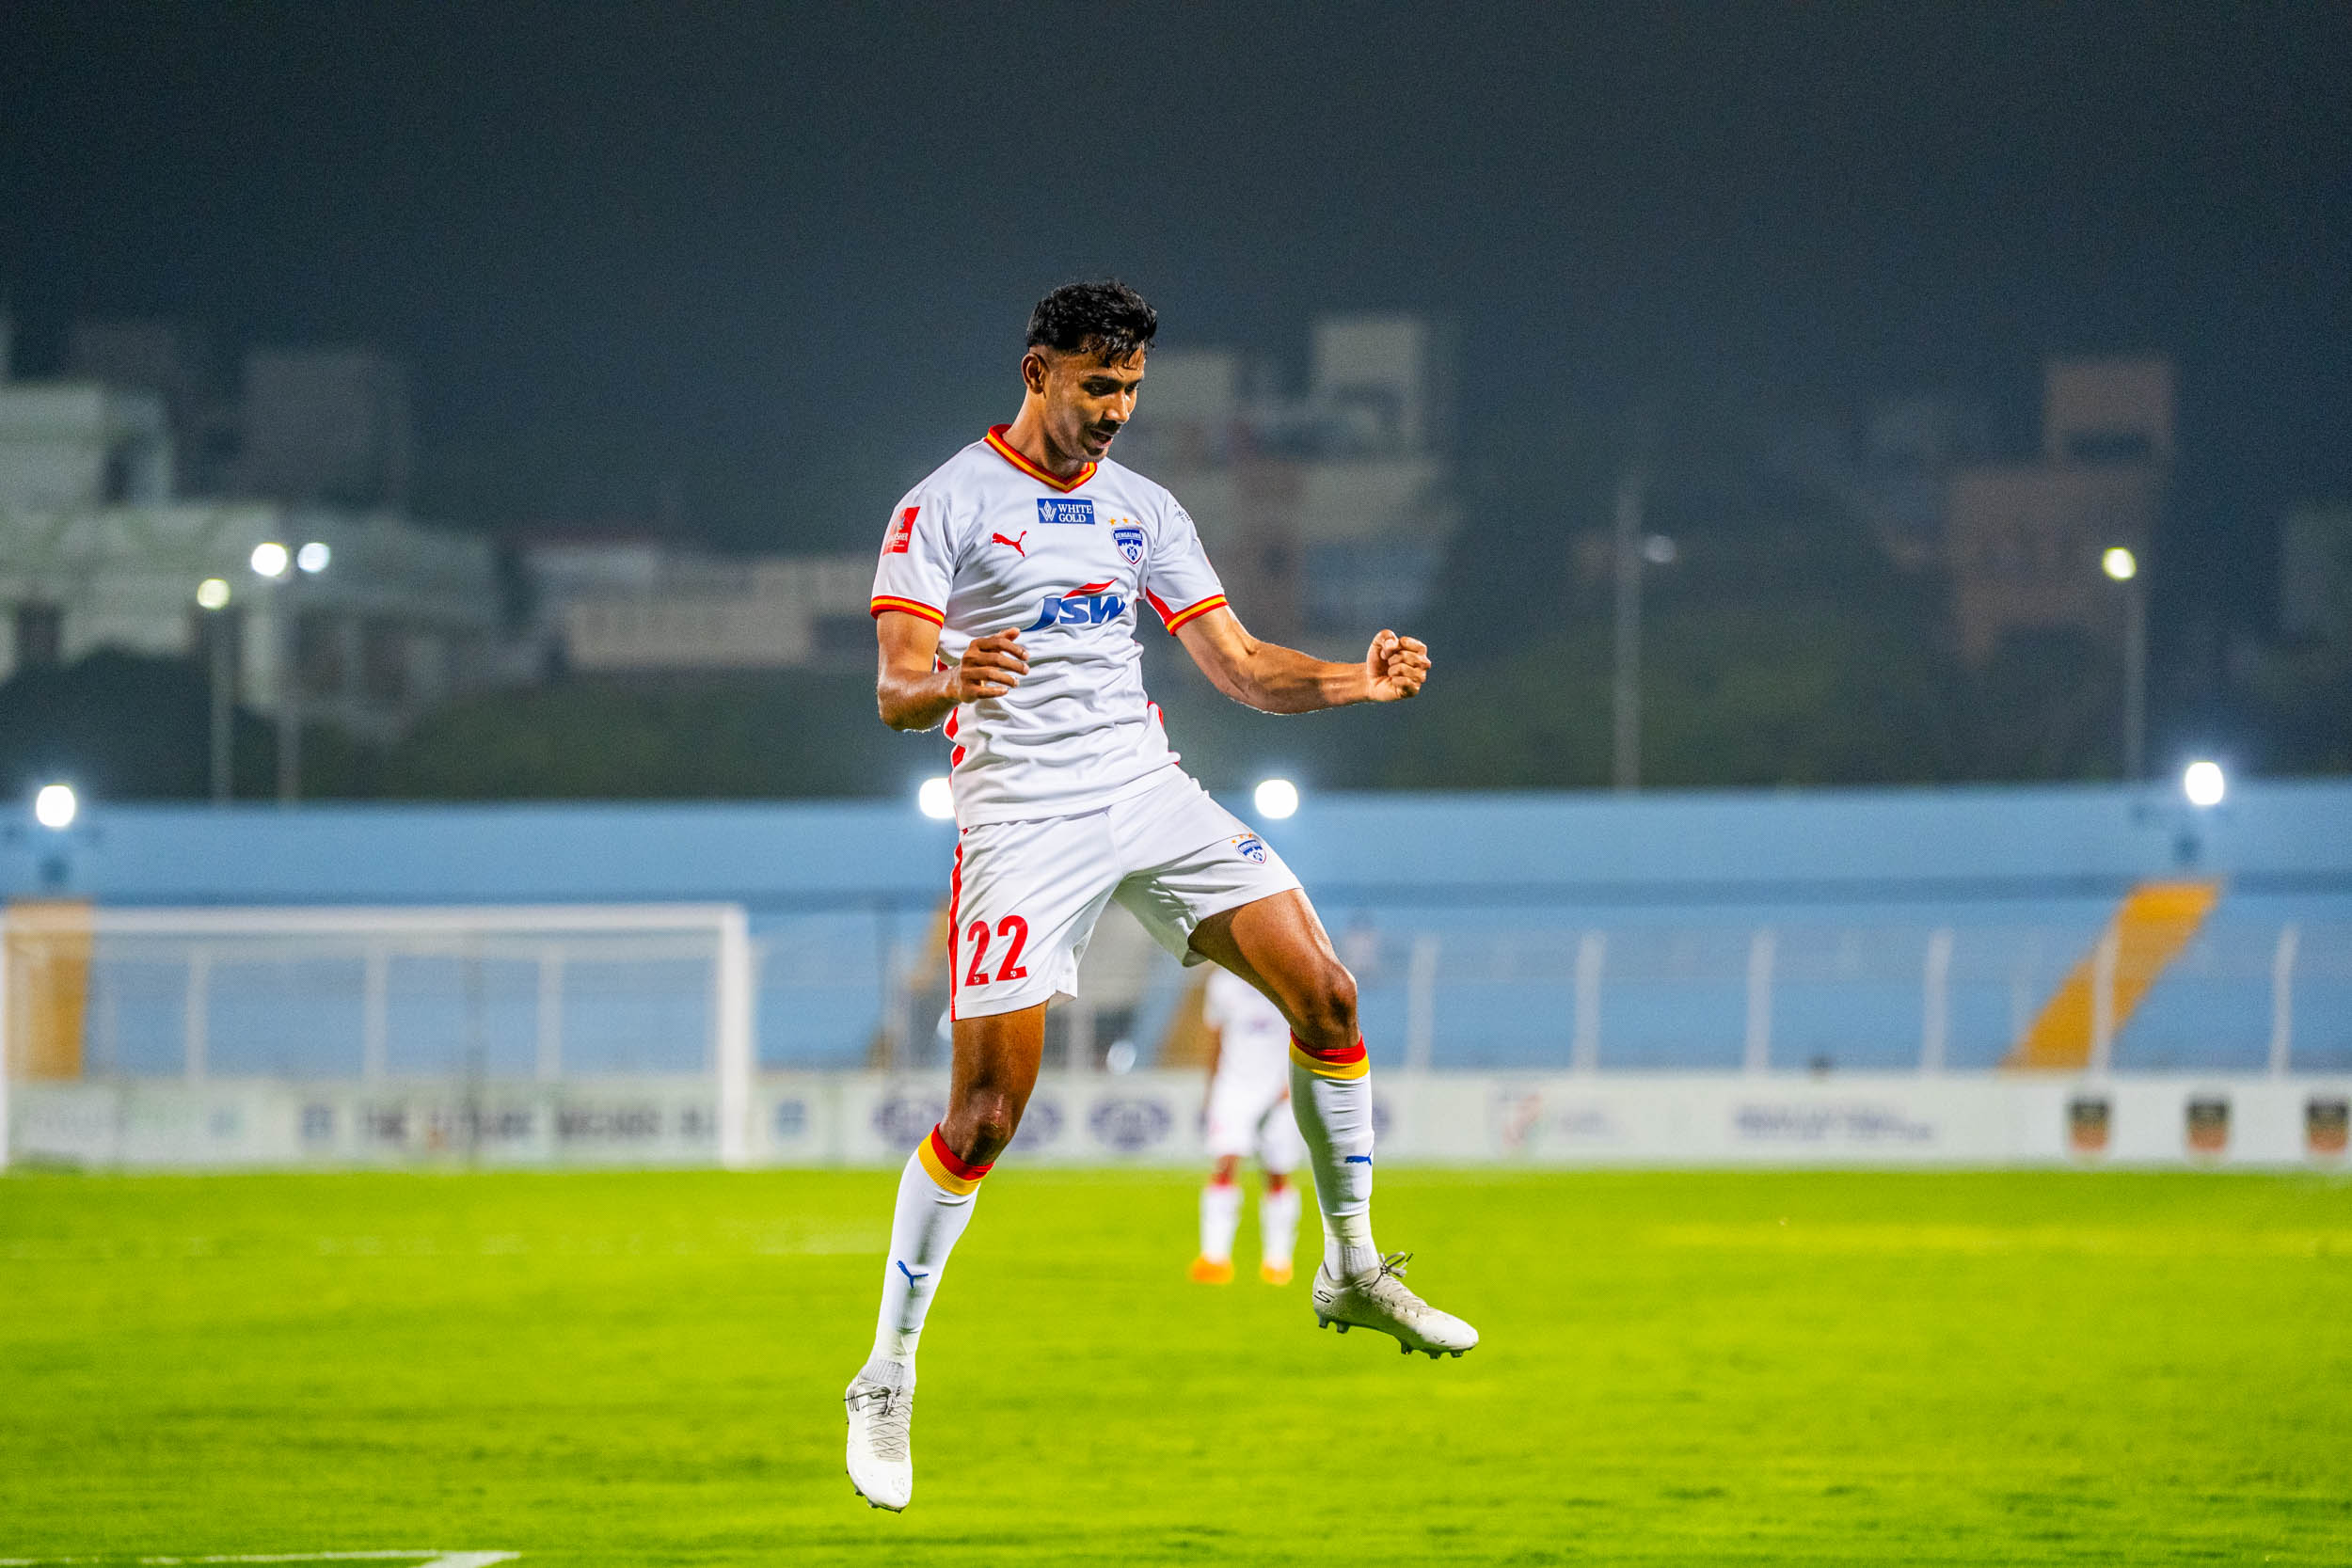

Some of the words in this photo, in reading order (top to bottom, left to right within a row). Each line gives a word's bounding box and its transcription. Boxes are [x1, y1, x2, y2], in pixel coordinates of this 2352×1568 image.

[1057, 503, 1092, 515] WHITE
[1058, 513, 1087, 523] GOLD
[1021, 595, 1126, 633] JSW
[964, 914, 1029, 988] 22
